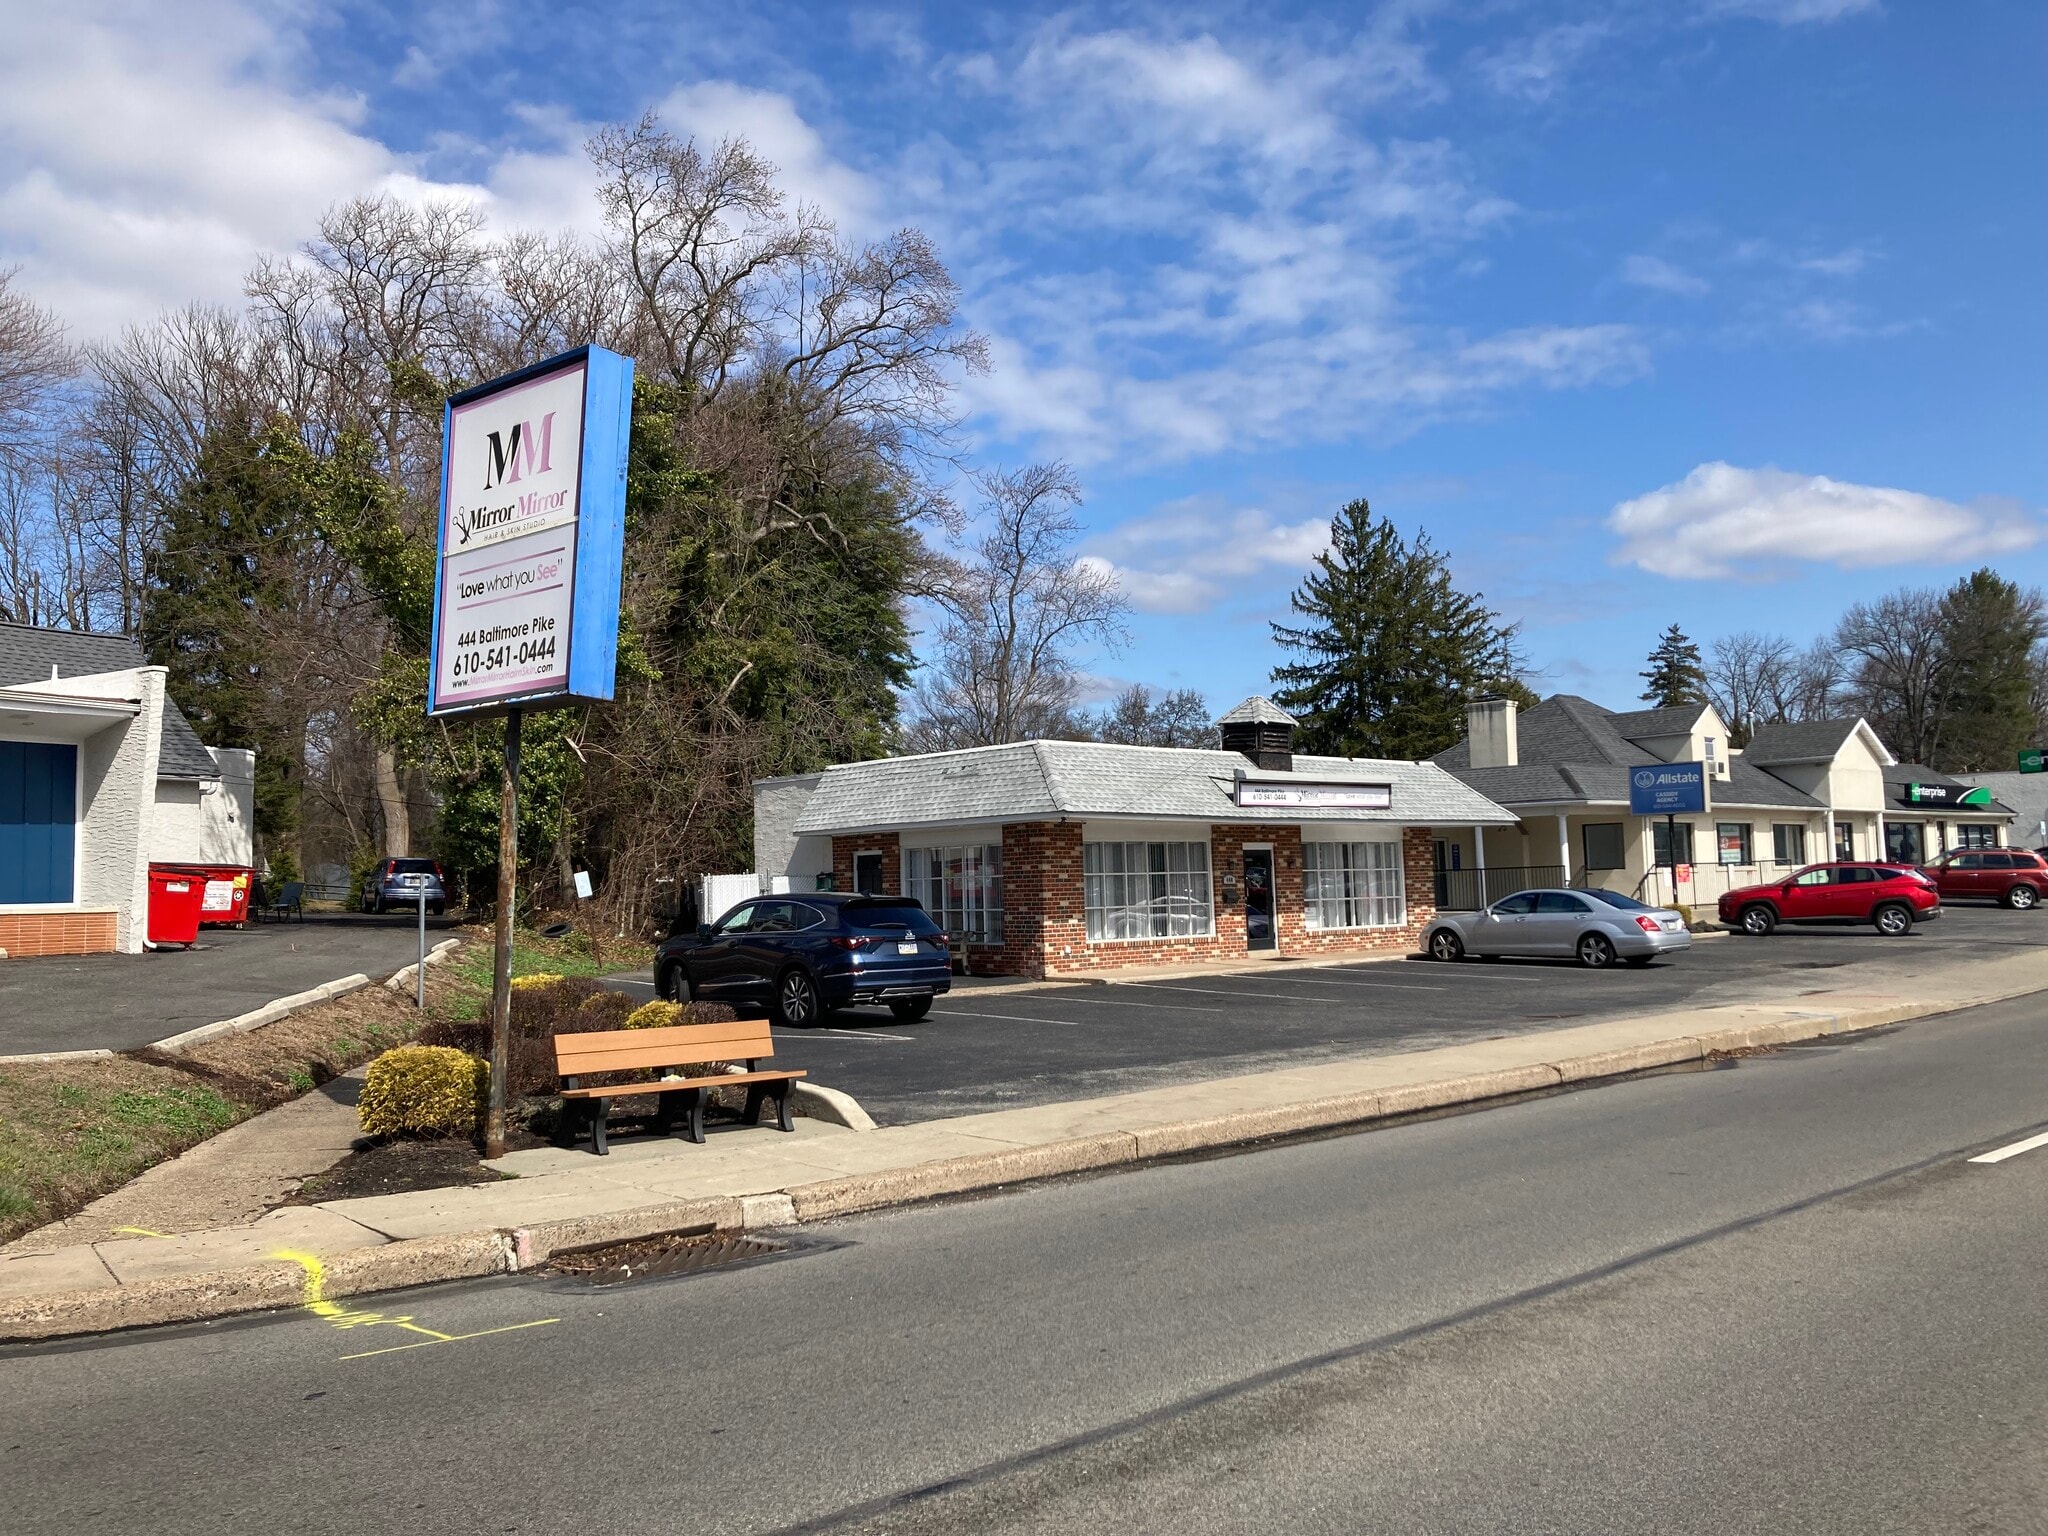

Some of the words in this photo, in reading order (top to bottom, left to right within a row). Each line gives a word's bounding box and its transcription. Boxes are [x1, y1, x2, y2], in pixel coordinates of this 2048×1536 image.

[483, 412, 556, 491] MM
[469, 504, 515, 530] Mirror
[516, 489, 568, 518] Mirror
[484, 529, 498, 541] HAIR
[500, 529, 506, 537] &
[507, 526, 521, 536] SKIN
[522, 518, 546, 531] STUDIO
[486, 571, 514, 591] what
[514, 570, 535, 590] you
[457, 630, 476, 648] 444
[479, 623, 529, 645] Baltimore
[532, 615, 555, 634] Pike
[453, 635, 556, 676] 610-541-0444
[1656, 772, 1699, 785] Allstate
[1912, 786, 1946, 799] enterprise
